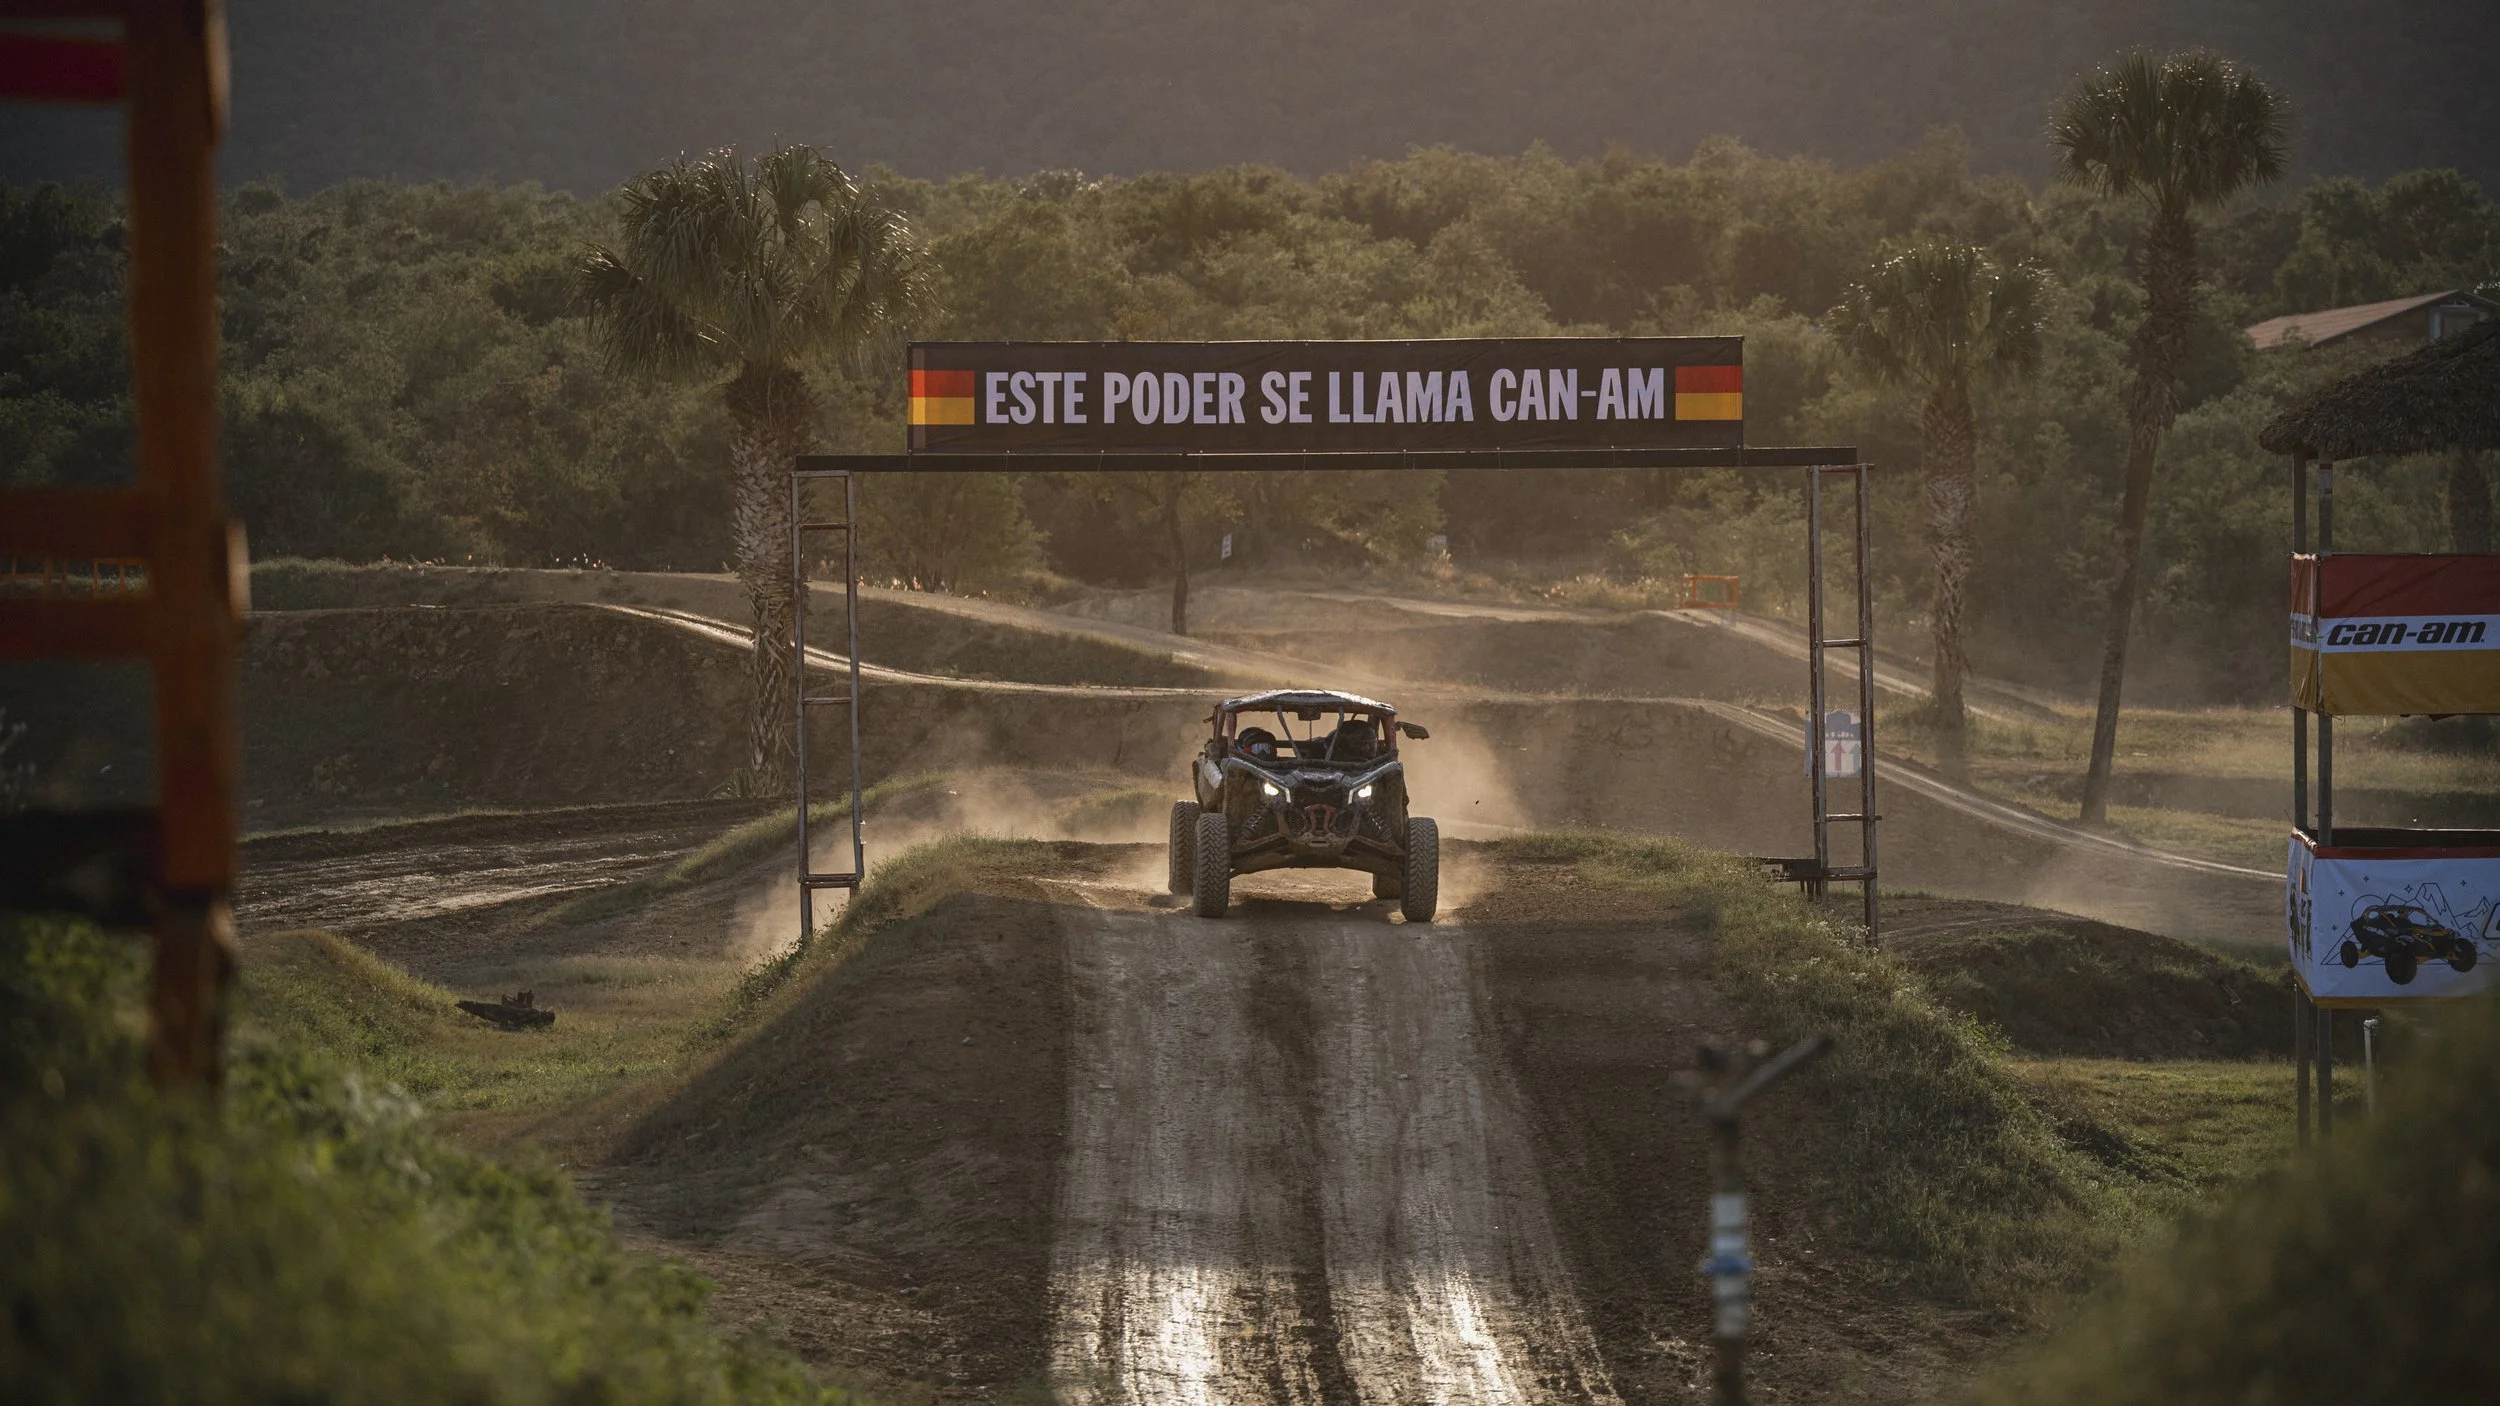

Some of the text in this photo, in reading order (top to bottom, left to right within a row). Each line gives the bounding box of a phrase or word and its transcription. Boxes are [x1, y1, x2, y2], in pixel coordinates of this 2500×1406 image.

[986, 367, 1665, 425] ESTE PODER SE LLAMA CAN-AM
[2327, 621, 2486, 646] can-am
